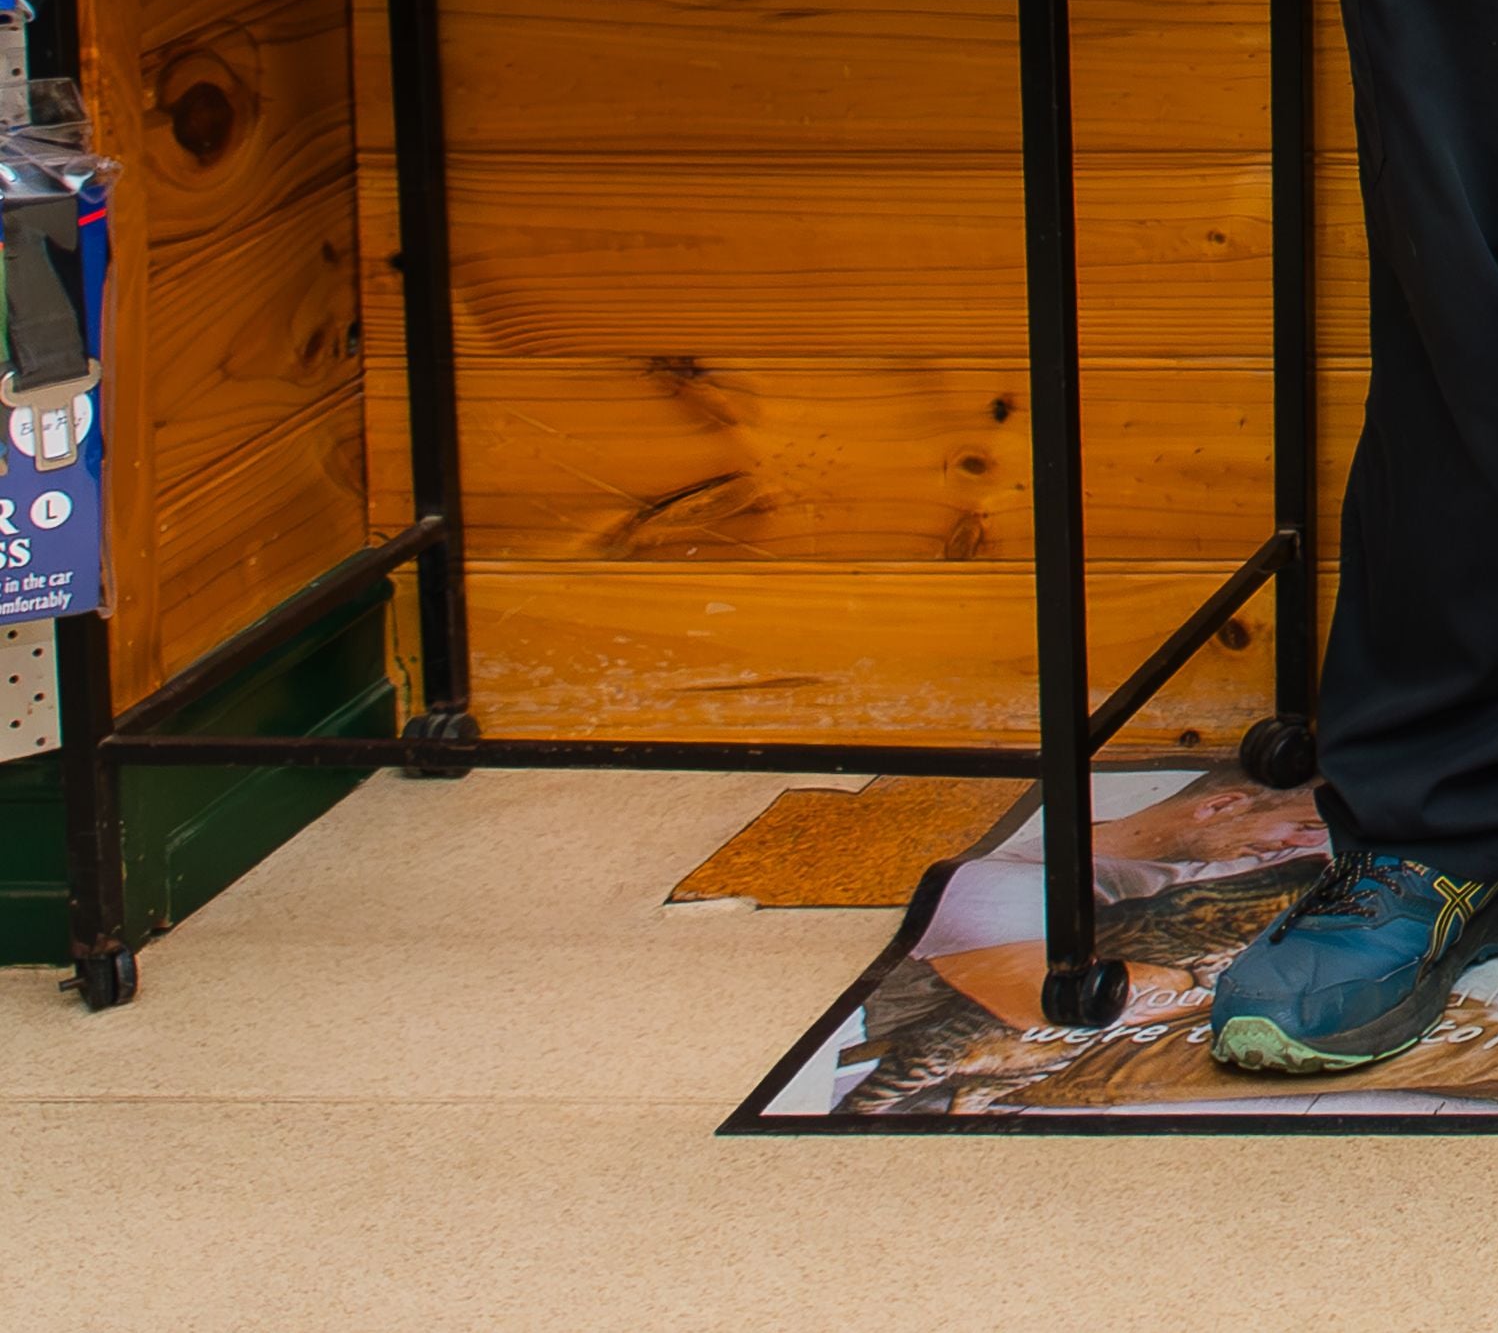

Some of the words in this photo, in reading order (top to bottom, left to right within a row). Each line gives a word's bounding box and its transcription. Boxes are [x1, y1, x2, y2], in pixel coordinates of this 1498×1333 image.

[45, 500, 57, 520] L
[5, 577, 19, 593] in
[23, 572, 46, 591] the
[49, 571, 73, 586] car
